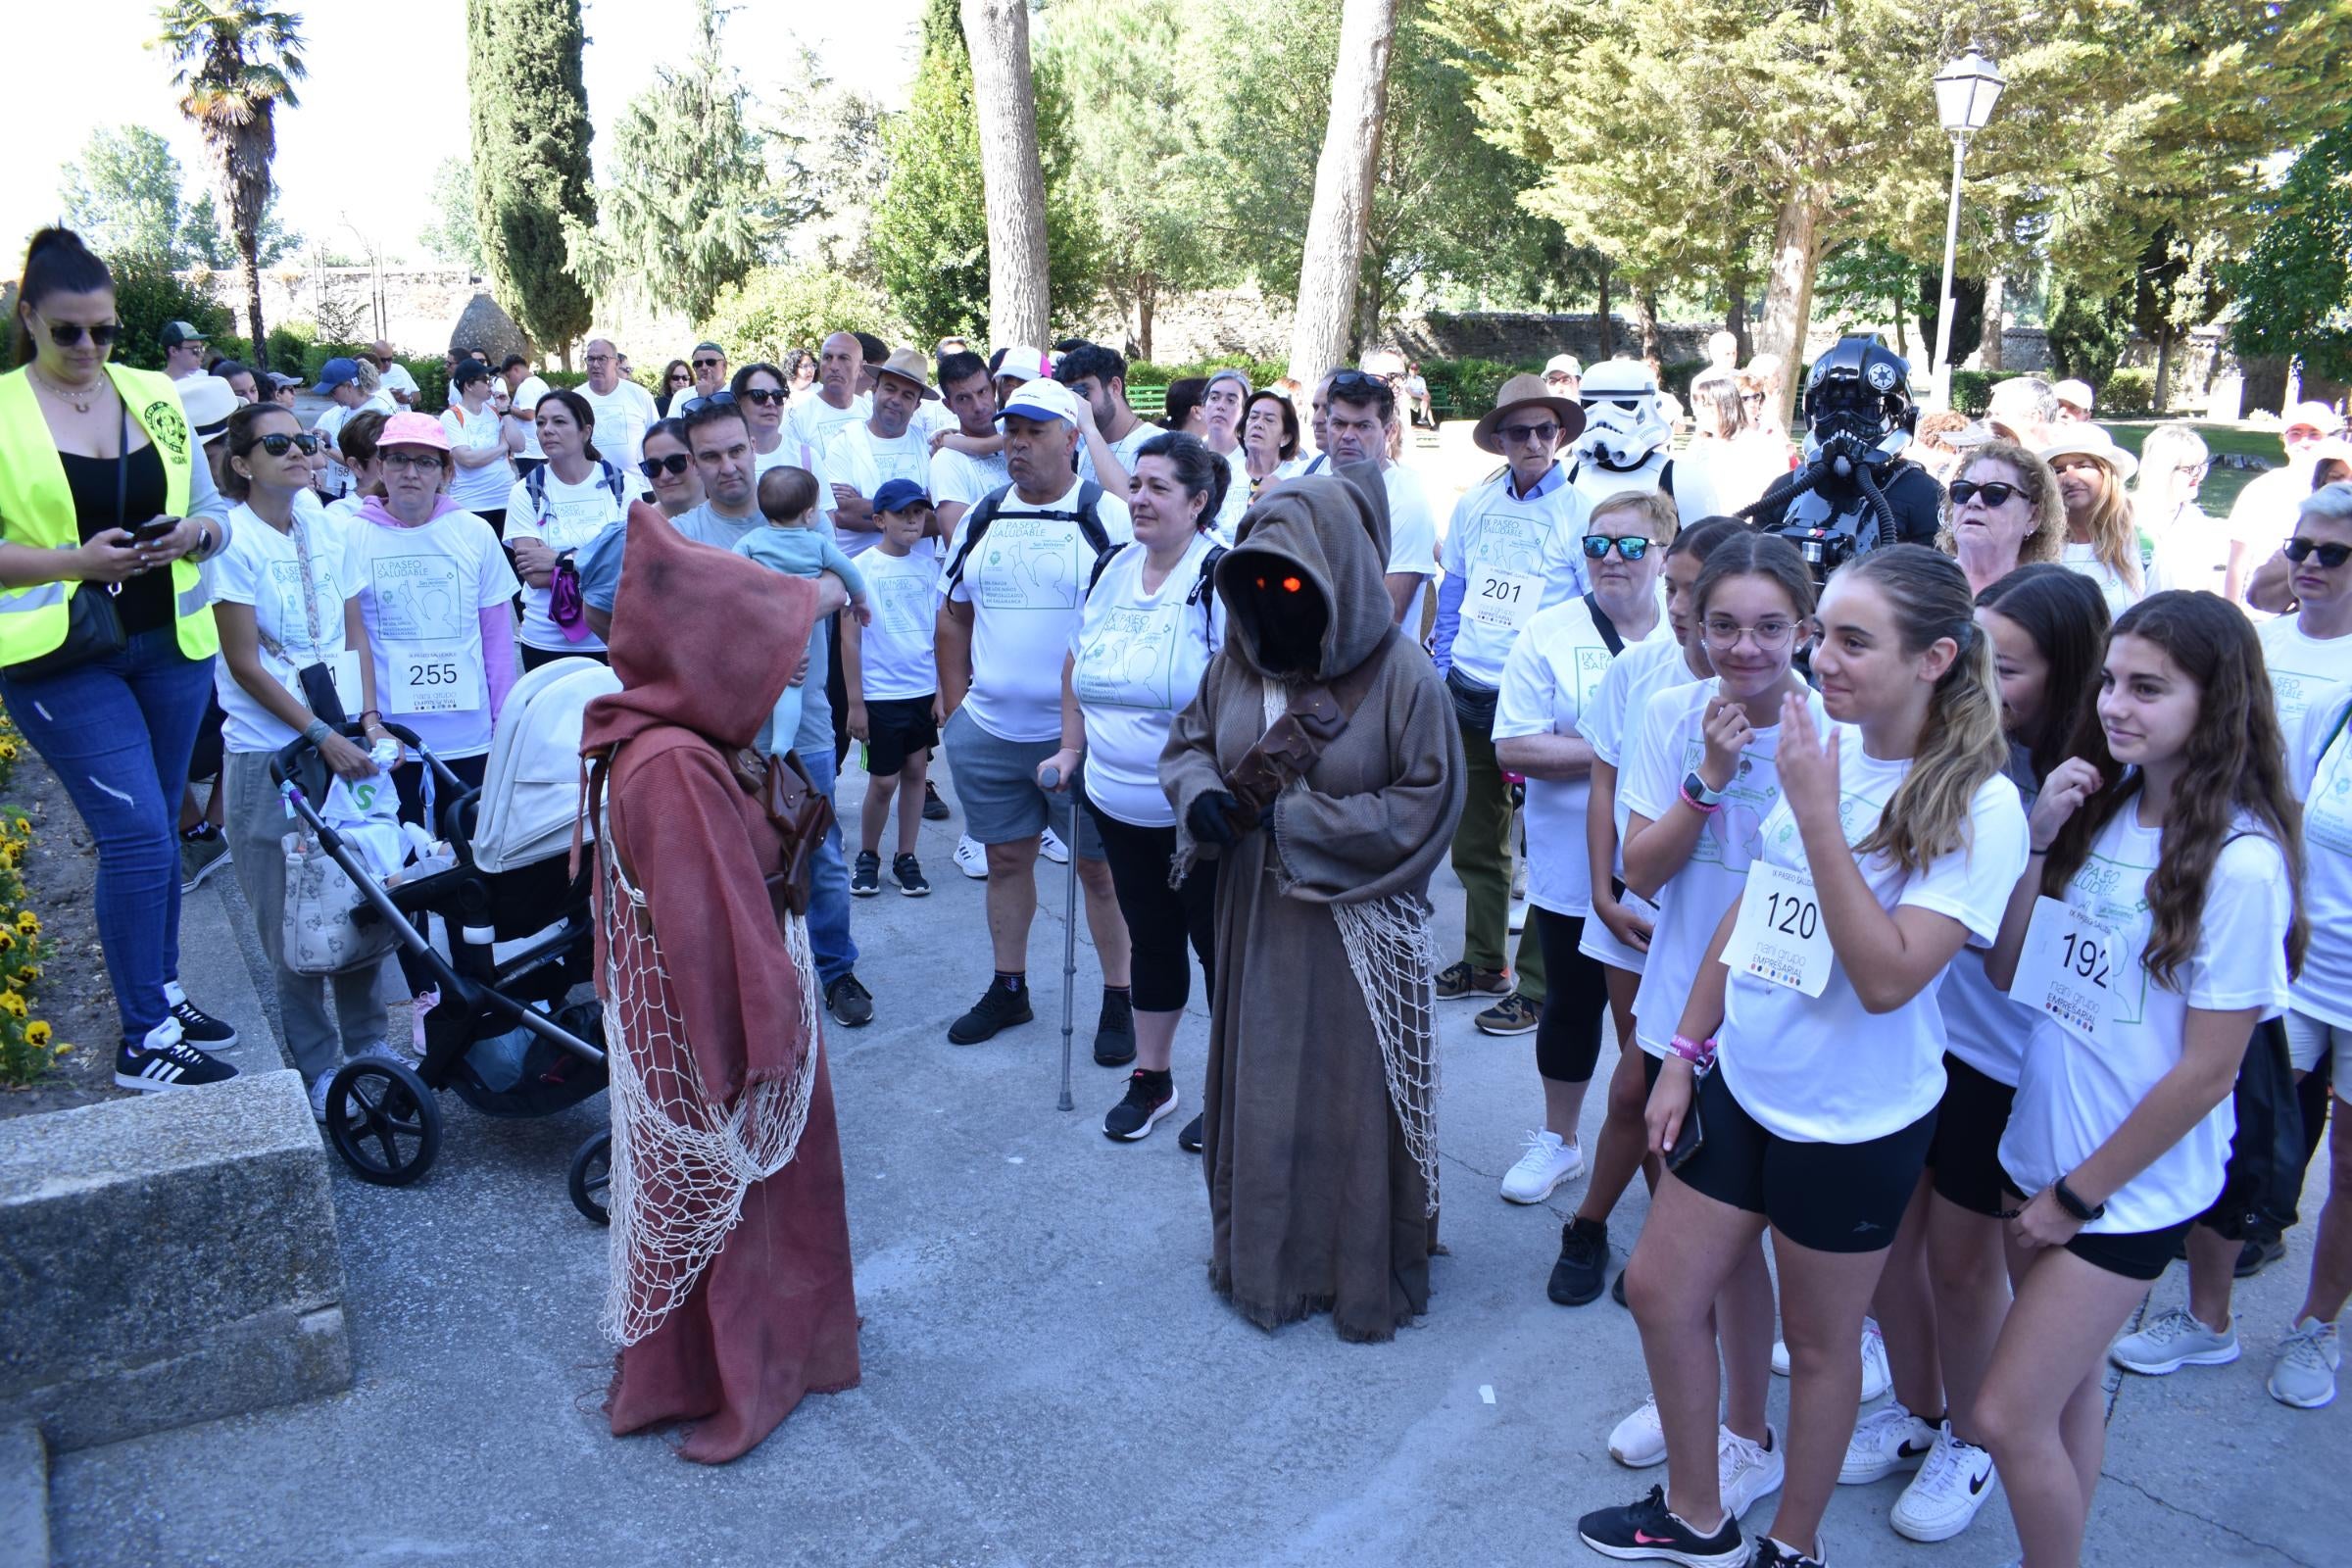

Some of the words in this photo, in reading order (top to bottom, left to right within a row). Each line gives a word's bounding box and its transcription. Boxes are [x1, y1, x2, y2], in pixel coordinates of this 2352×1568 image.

[334, 466, 350, 477] 158
[1005, 520, 1040, 529] PASEO
[1494, 519, 1520, 529] PASEO
[992, 528, 1047, 538] SALUDABLE
[1484, 526, 1523, 537] SALUDABLE
[389, 560, 421, 569] PASEO
[377, 567, 428, 579] SALUDABLE
[1482, 578, 1521, 603] 201
[1582, 652, 1593, 662] IX
[1599, 653, 1614, 662] PA
[410, 663, 458, 686] 255
[1689, 747, 1699, 760] IX
[1778, 871, 1795, 882] PASEO
[1768, 892, 1817, 940] 120
[2077, 912, 2093, 925] PASEO
[1755, 942, 1776, 954] nani
[1778, 948, 1806, 965] grupo
[1752, 954, 1802, 978] EMPRESARIAL
[2063, 932, 2109, 989] 192
[2050, 980, 2070, 998] nani
[2073, 992, 2100, 1014] grupo
[2047, 992, 2096, 1026] EMPRESARIAL
